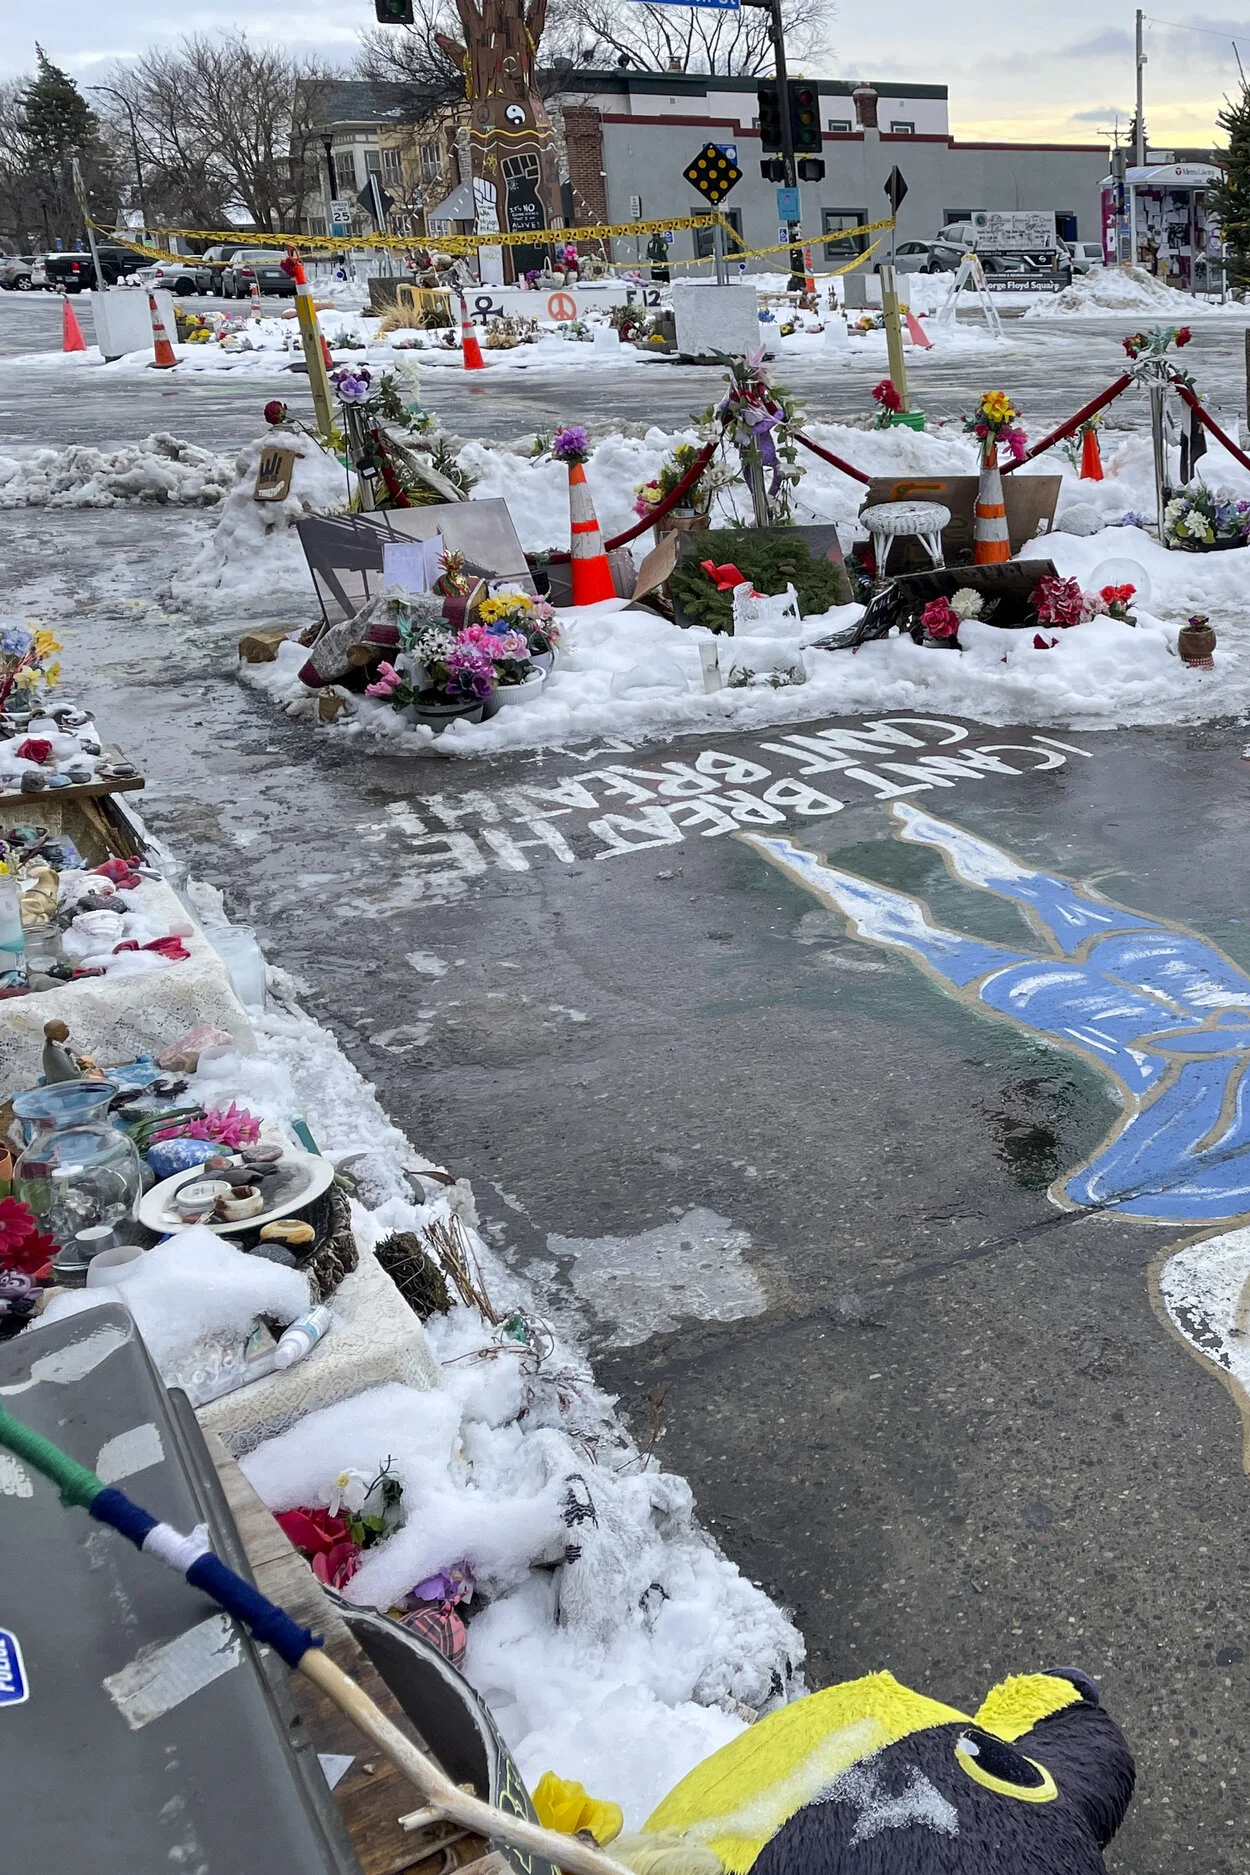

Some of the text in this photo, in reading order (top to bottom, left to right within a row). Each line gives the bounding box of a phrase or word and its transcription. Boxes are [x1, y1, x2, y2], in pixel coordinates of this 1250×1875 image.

[523, 203, 535, 212] NO
[333, 212, 350, 222] 25
[1007, 281, 1029, 291] Floyd
[1030, 281, 1060, 291] Square
[759, 718, 969, 775] CANT
[844, 744, 1067, 799] CANT
